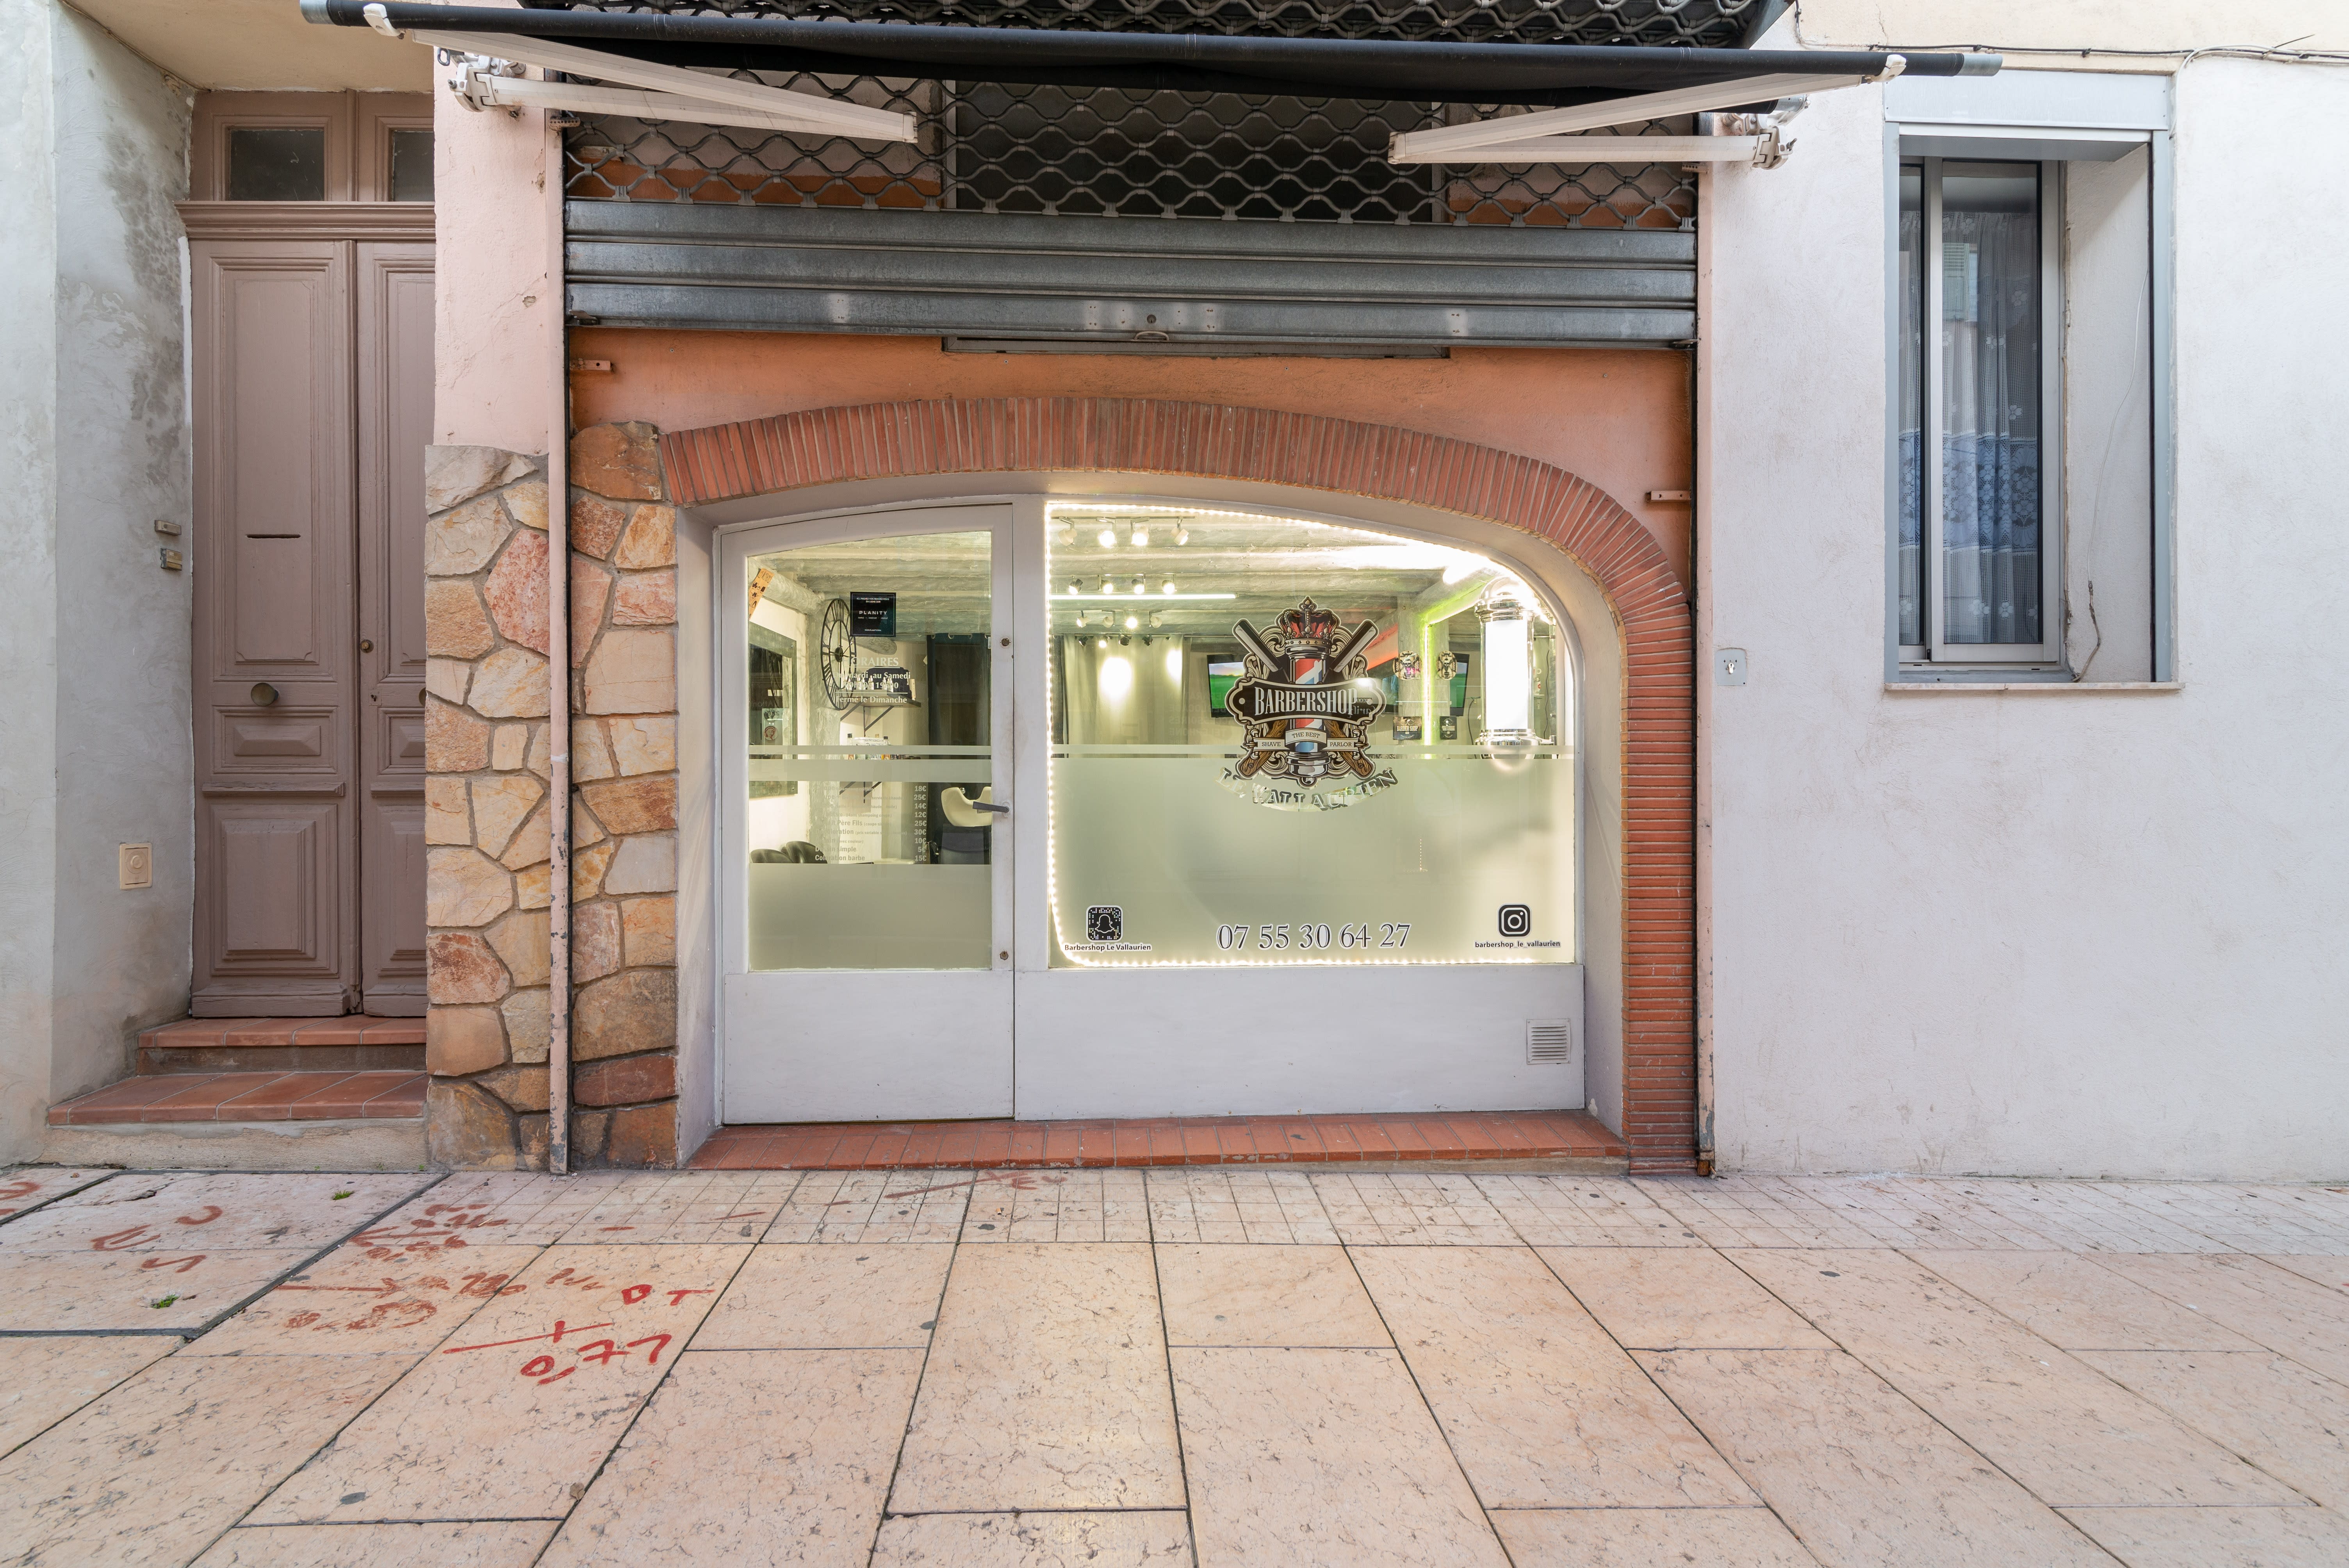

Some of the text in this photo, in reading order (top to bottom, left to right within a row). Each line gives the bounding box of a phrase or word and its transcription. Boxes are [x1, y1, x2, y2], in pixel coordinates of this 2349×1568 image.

[845, 657, 899, 666] ORAIRES
[1255, 687, 1358, 716] BARBERSHOP
[1217, 923, 1411, 949] 07 55 30 64 27
[1475, 940, 1560, 948] barbershop_le_vallaurien
